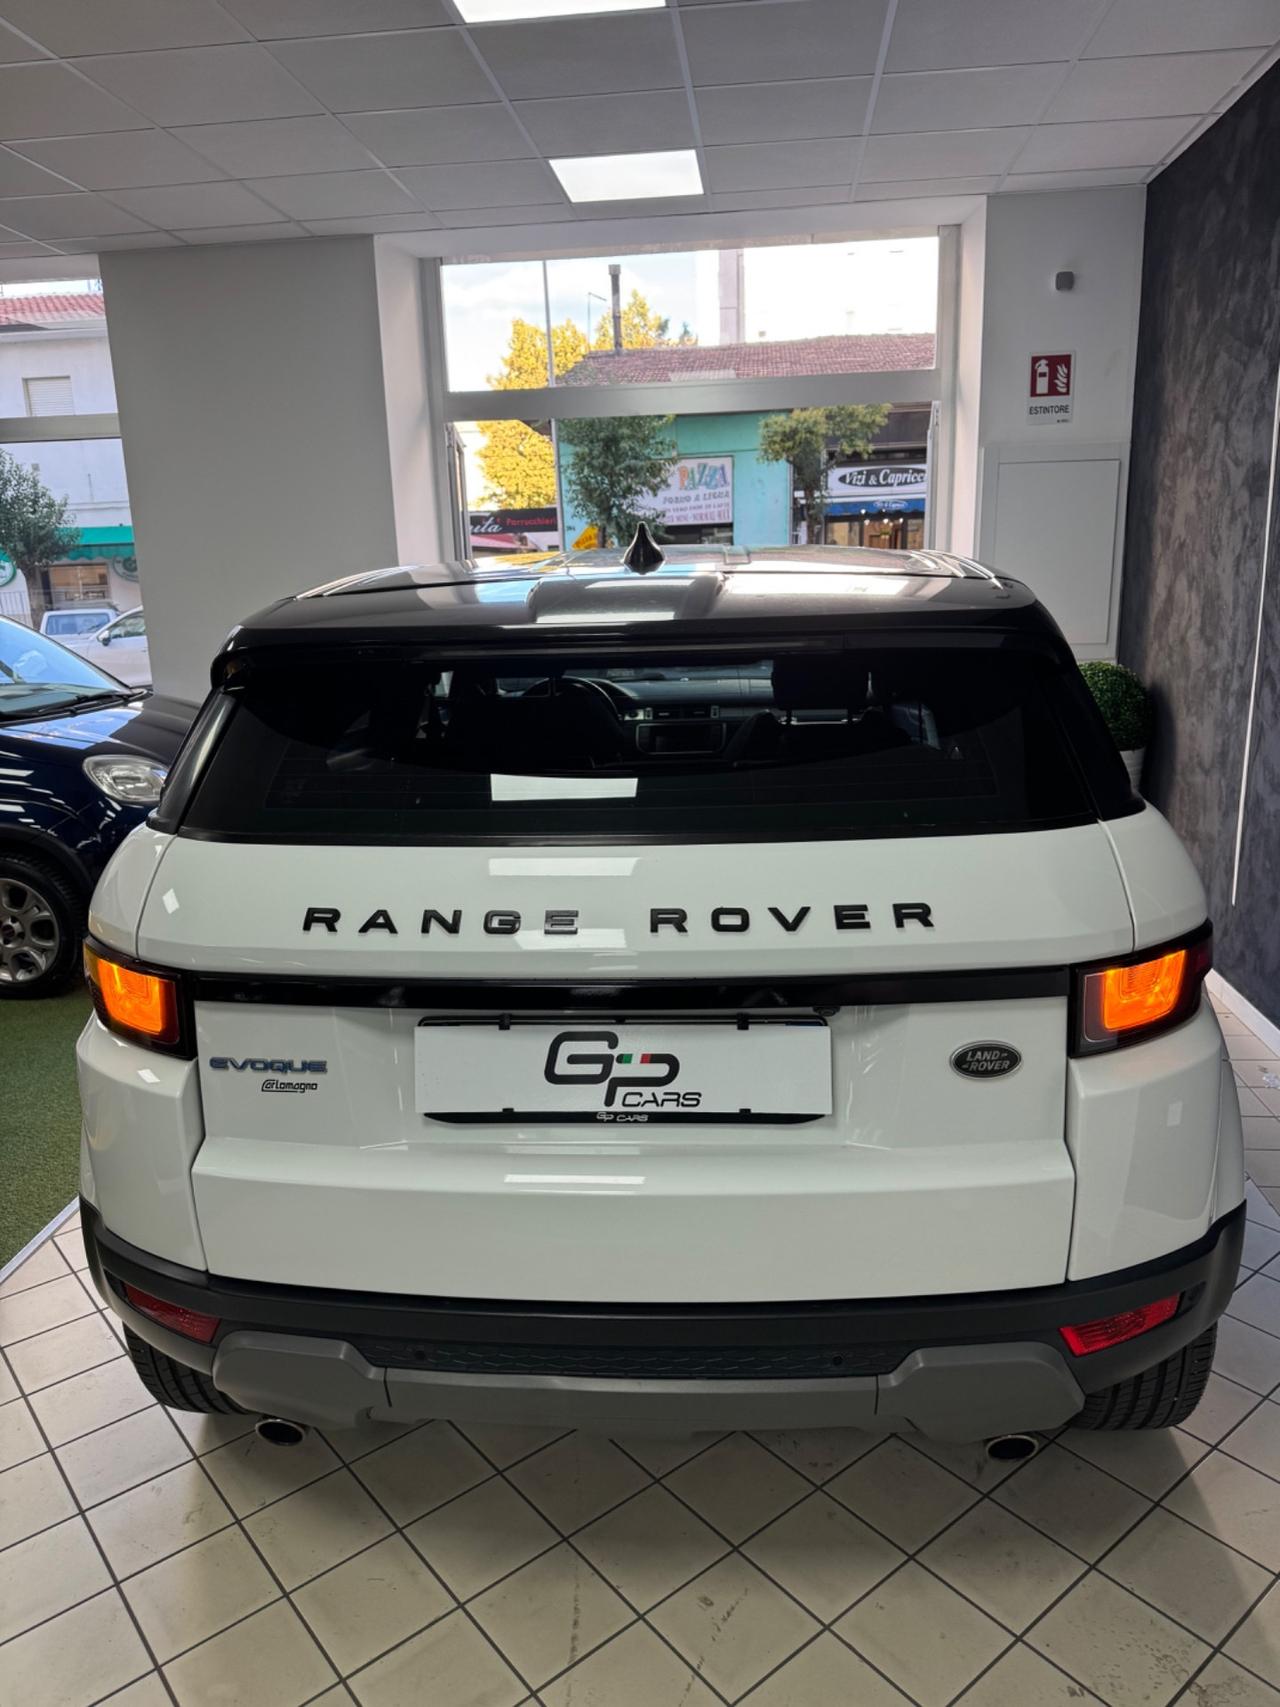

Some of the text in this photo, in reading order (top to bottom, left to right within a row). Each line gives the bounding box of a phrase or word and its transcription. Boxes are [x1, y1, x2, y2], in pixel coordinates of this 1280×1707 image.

[1029, 404, 1070, 415] ESTINTORE
[868, 474, 878, 485] &
[302, 902, 935, 935] RANGE ROVER
[966, 1050, 999, 1061] LAND
[209, 1056, 328, 1075] EVOQUE
[969, 1060, 1010, 1072] ROVER
[622, 1091, 702, 1108] CARS
